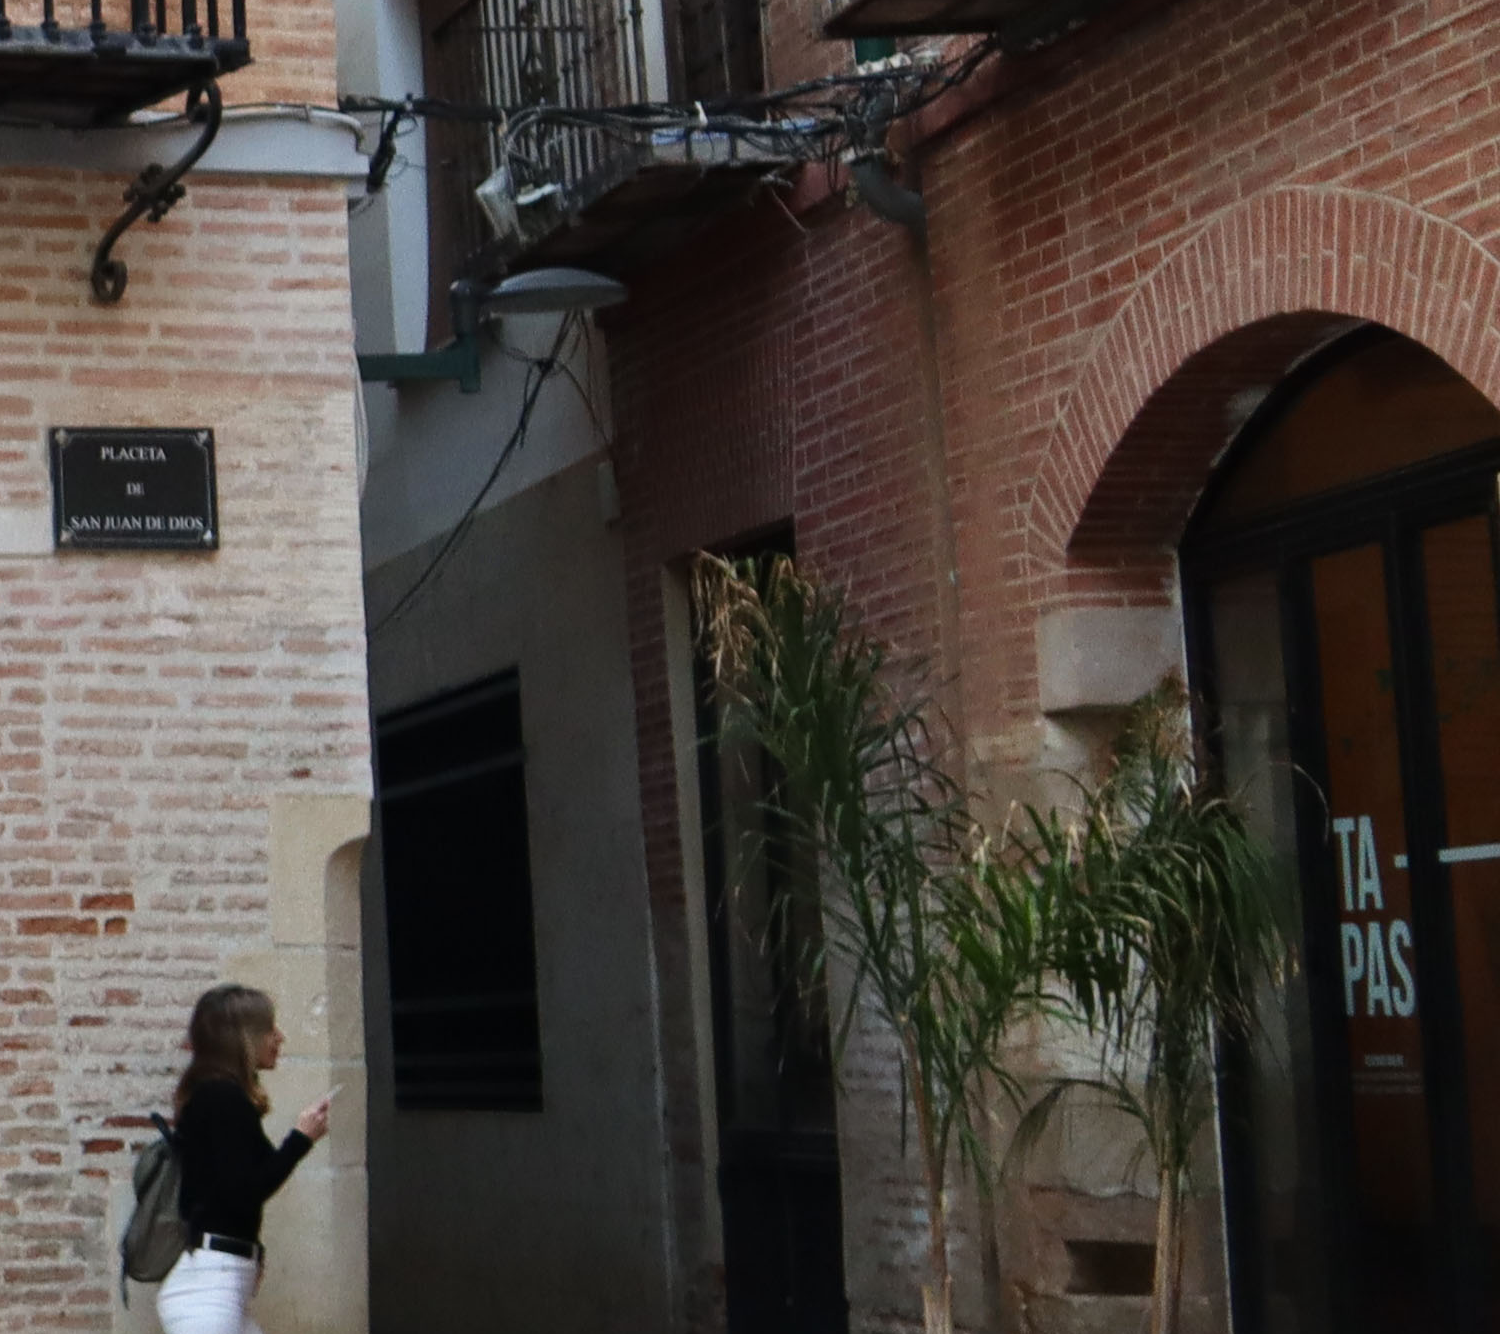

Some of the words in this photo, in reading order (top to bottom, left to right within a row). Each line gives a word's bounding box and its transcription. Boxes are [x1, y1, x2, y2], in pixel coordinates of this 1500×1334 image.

[101, 446, 167, 462] PLACETA
[126, 483, 145, 496] DE
[71, 516, 100, 530] SAN
[103, 516, 141, 530] JUAN
[145, 516, 166, 530] DE
[169, 516, 204, 530] DIOS
[1340, 919, 1416, 1018] PAS
